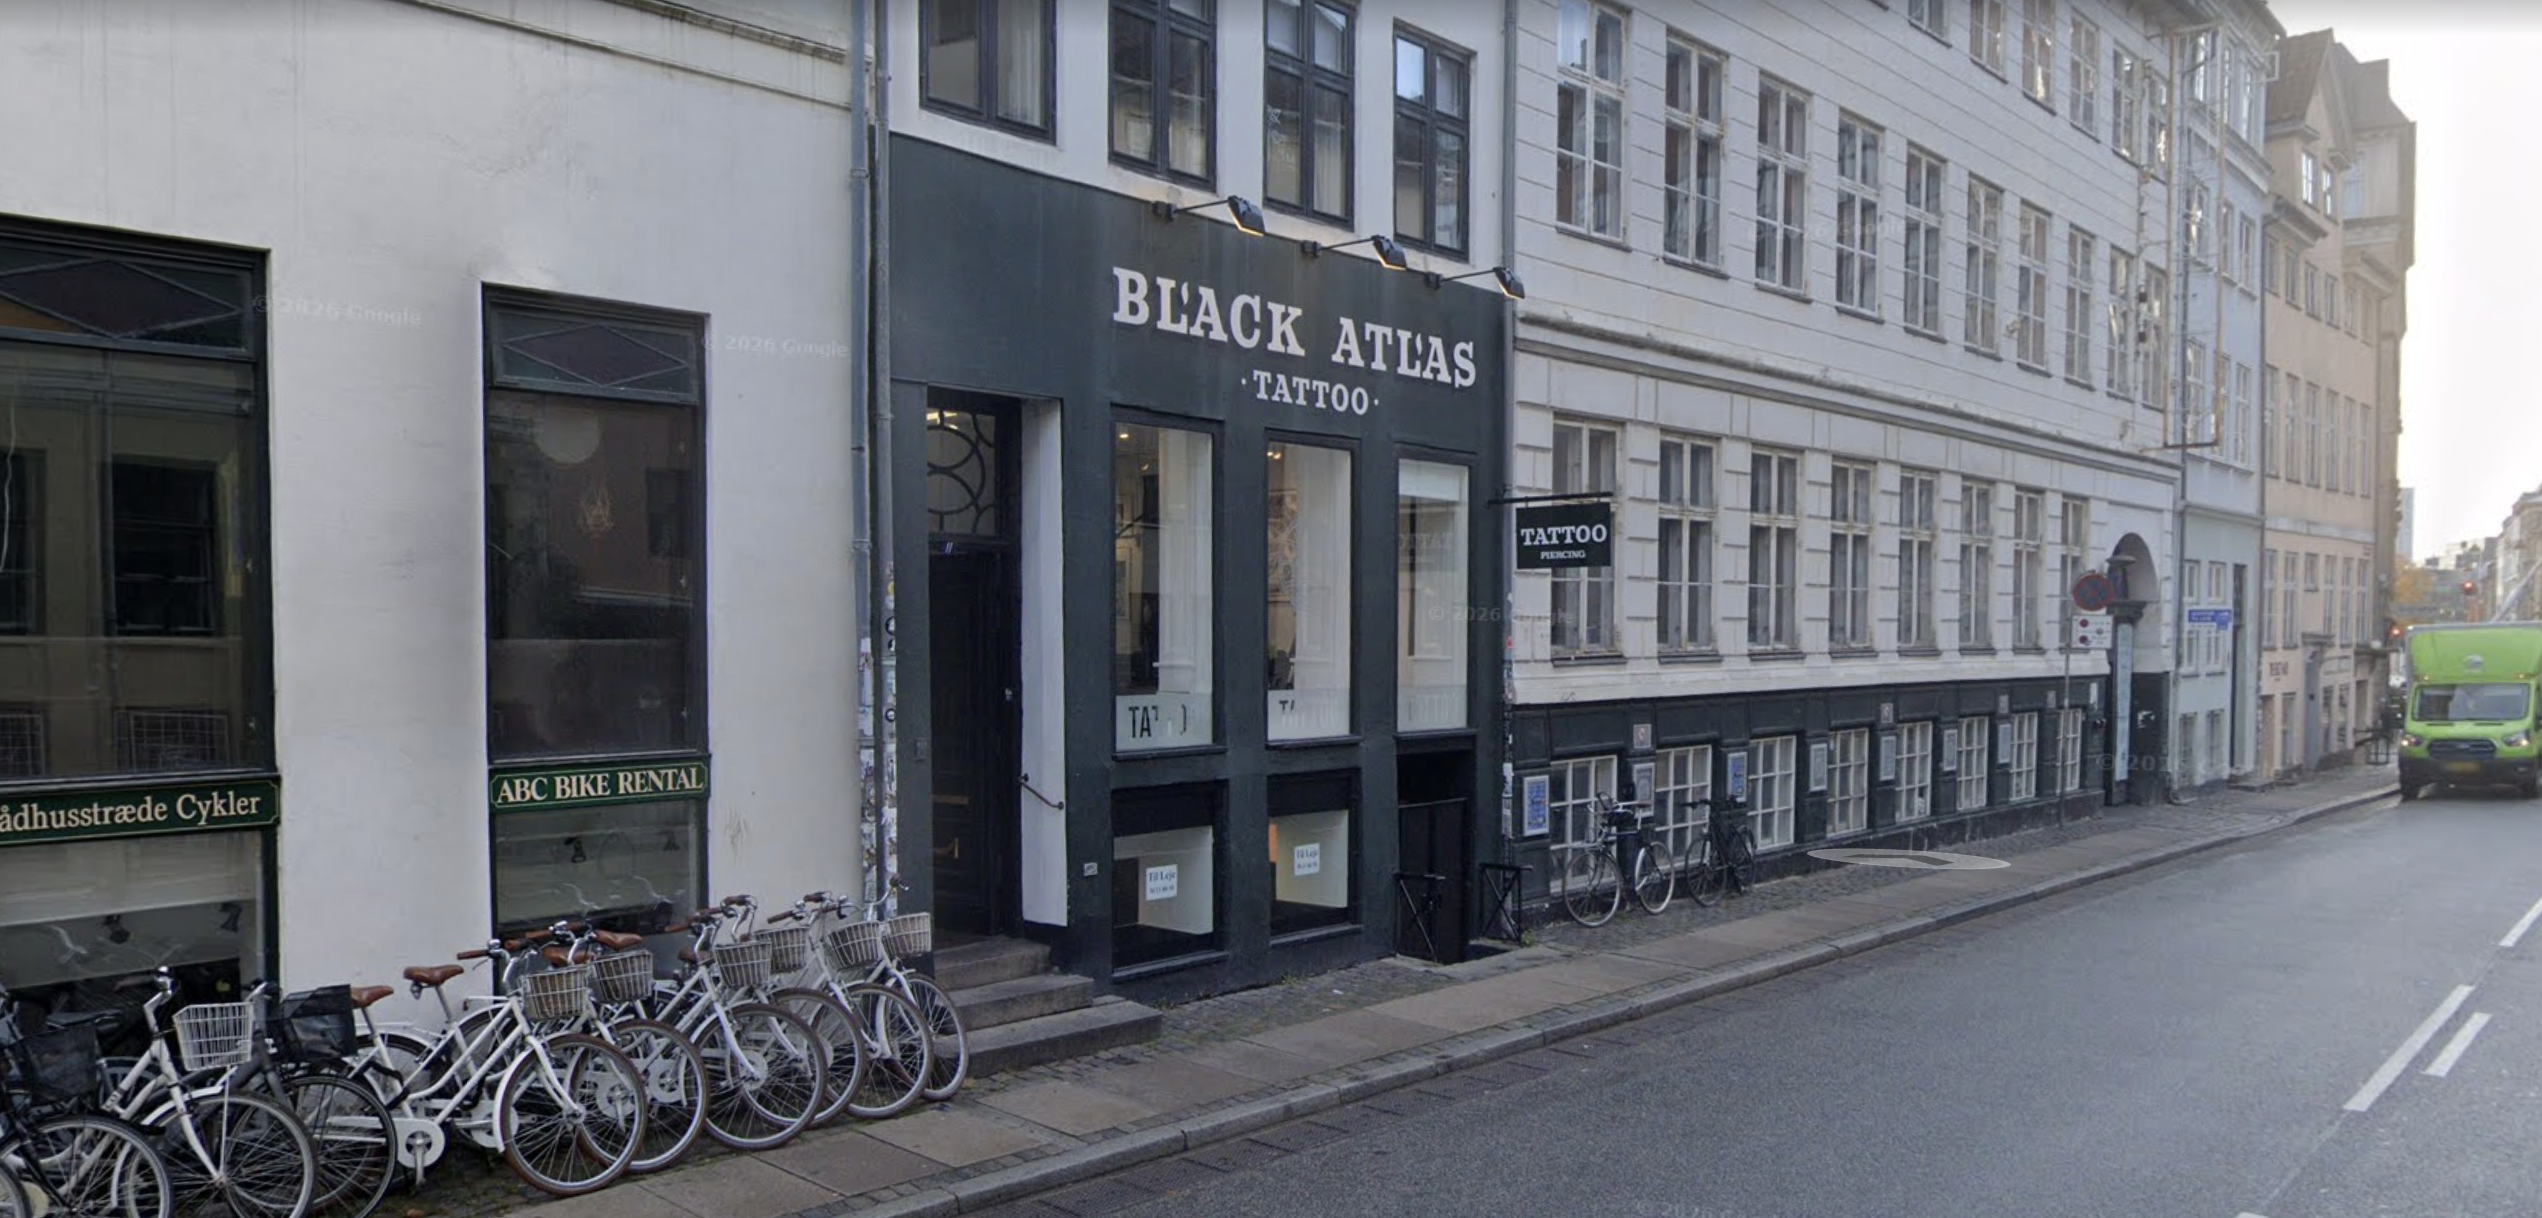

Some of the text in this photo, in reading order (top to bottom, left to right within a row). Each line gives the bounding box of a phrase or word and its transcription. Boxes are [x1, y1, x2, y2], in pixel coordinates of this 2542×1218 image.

[1112, 266, 1477, 388] BLACK ATLAS
[1521, 524, 1608, 546] TATTOO
[1540, 550, 1586, 560] PIERCING
[497, 766, 703, 803] ABC BIKE RENTAL
[0, 790, 261, 832] ådhusstræde Cykler
